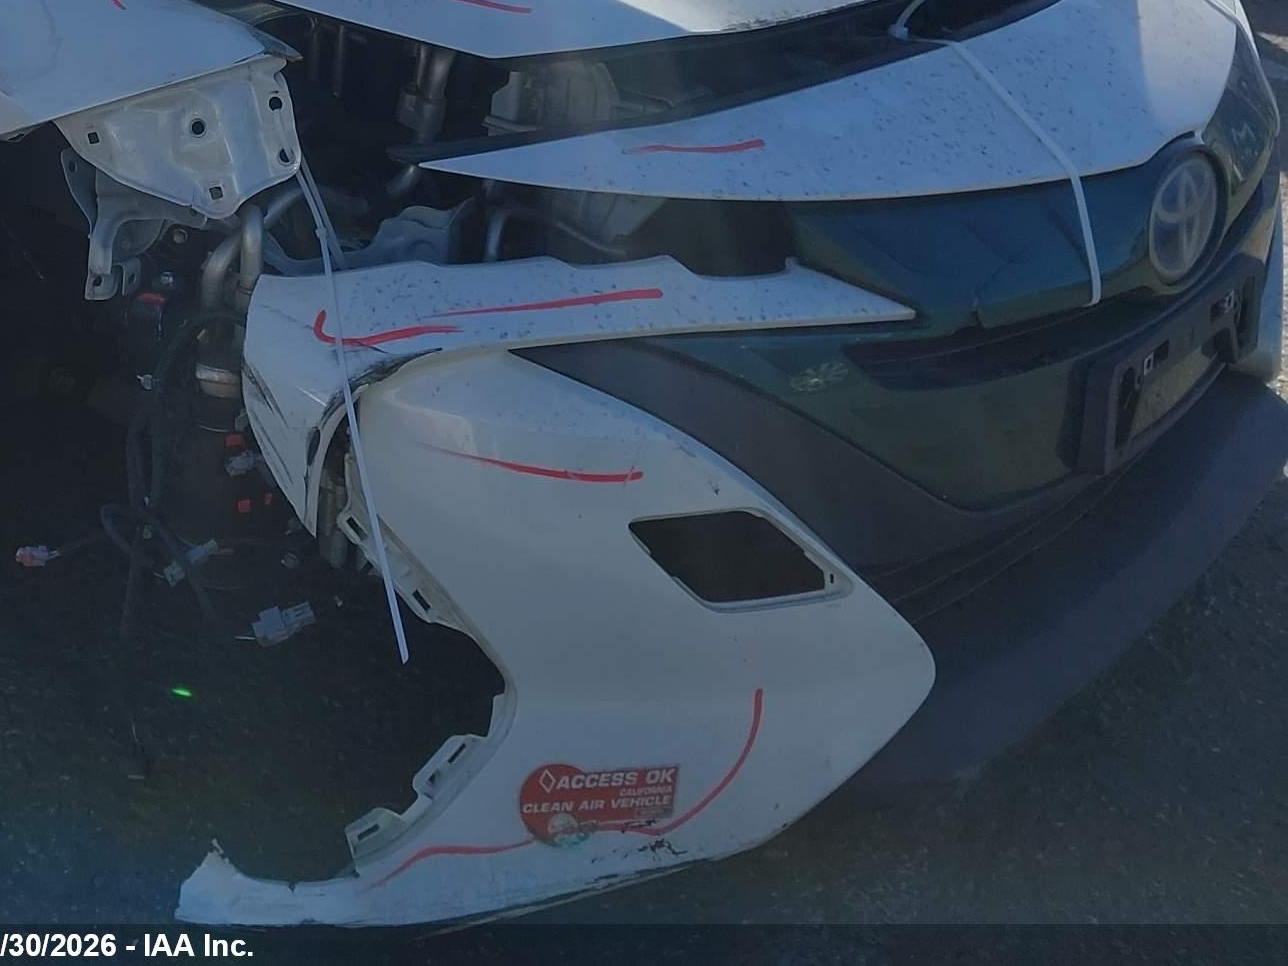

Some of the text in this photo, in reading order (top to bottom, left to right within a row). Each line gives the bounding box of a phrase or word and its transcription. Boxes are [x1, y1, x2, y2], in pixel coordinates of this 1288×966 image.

[556, 768, 675, 789] ACCESS OK
[619, 785, 672, 797] CALIFORNIA
[522, 795, 672, 814] CLEAN AIR VEHICLE
